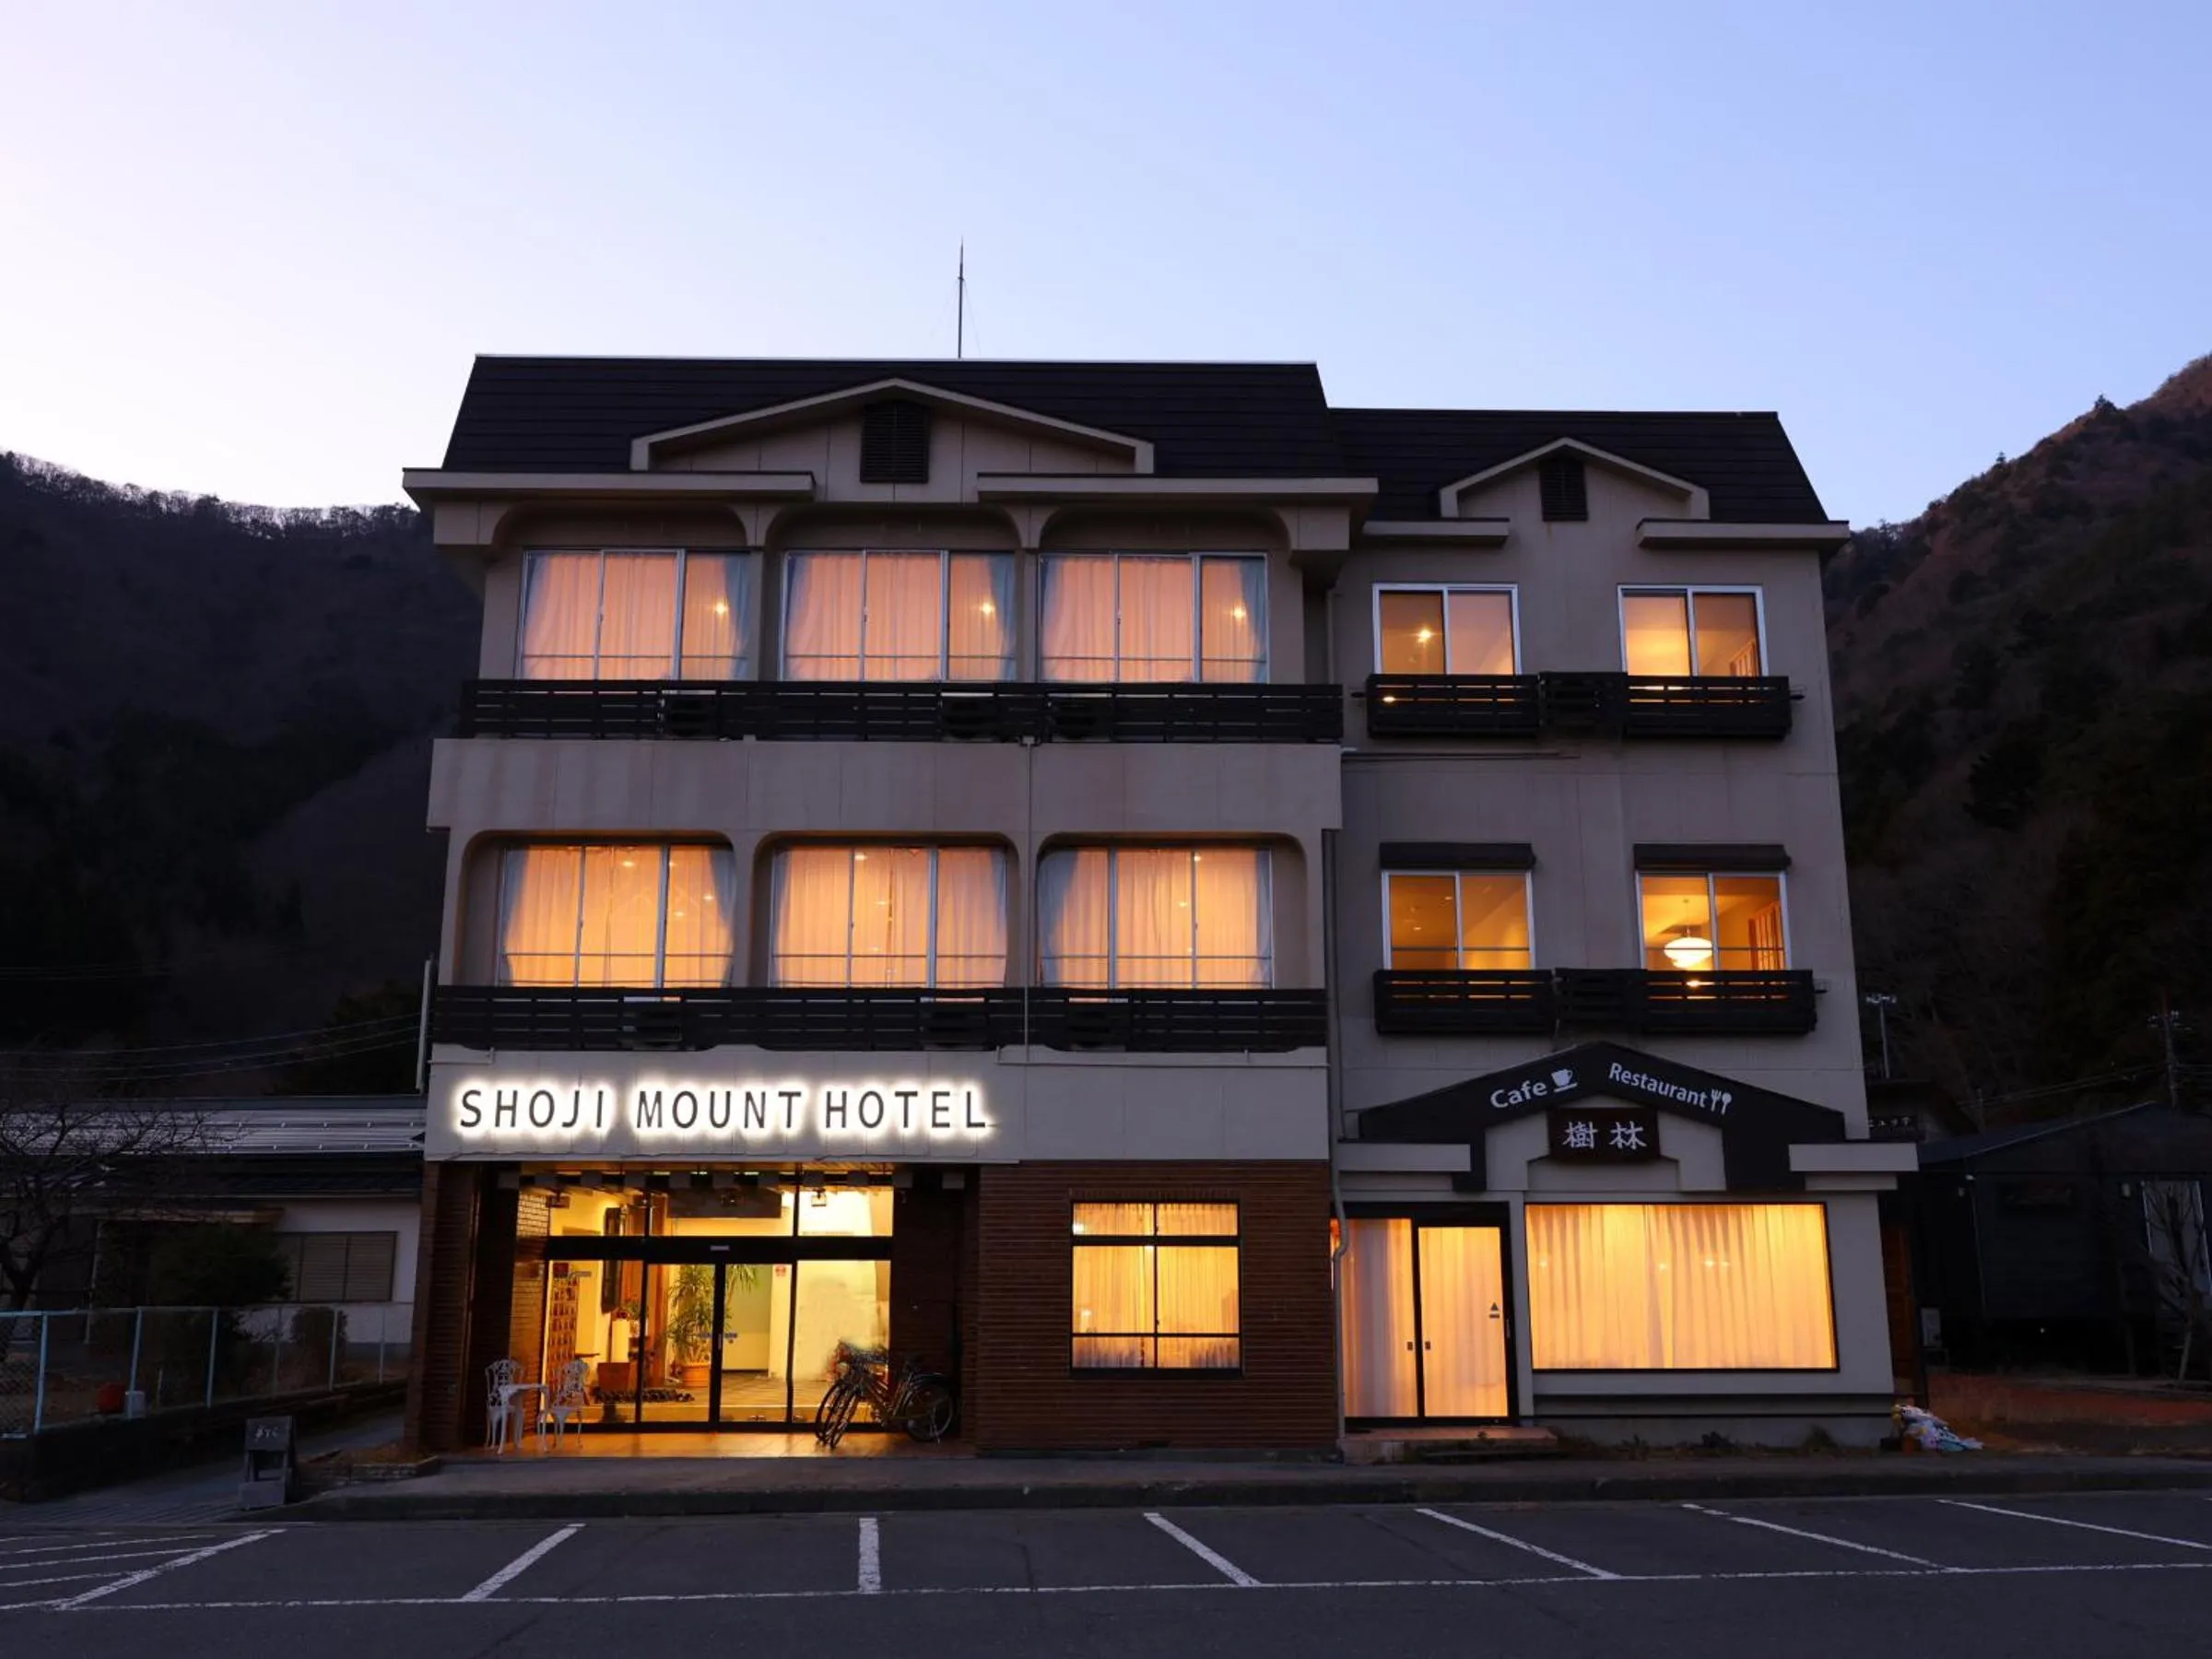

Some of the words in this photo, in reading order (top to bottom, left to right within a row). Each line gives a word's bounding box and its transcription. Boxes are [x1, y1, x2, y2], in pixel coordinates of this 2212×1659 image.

[1490, 1080, 1547, 1109] Cafe
[1609, 1063, 1709, 1108] Restaurant
[460, 1089, 604, 1128] SHOJI
[636, 1089, 802, 1129] MOUNT
[825, 1089, 987, 1129] HOTEL
[1563, 1121, 1647, 1150] 樹林
